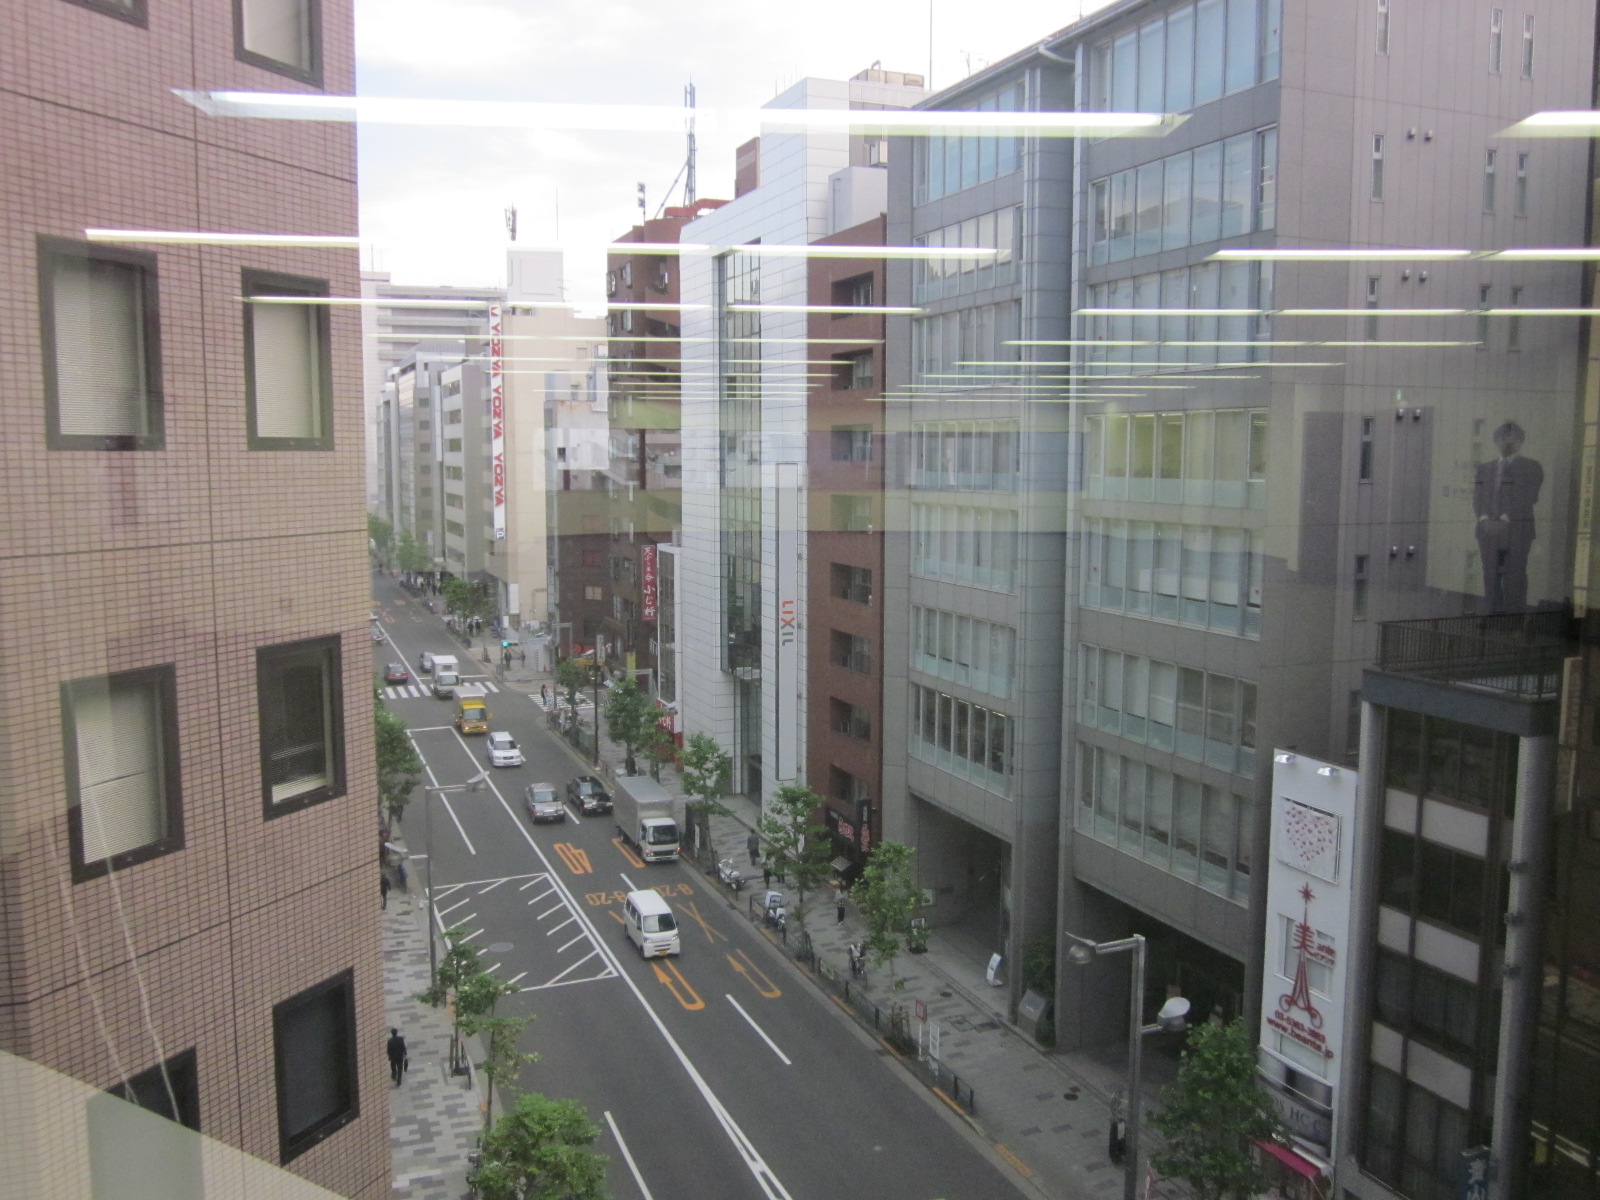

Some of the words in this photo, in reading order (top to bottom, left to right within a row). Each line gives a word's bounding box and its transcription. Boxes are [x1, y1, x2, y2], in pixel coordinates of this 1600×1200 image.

[492, 385, 504, 440] YOZYA
[494, 452, 505, 508] YOZYA
[781, 600, 795, 647] LIXIL
